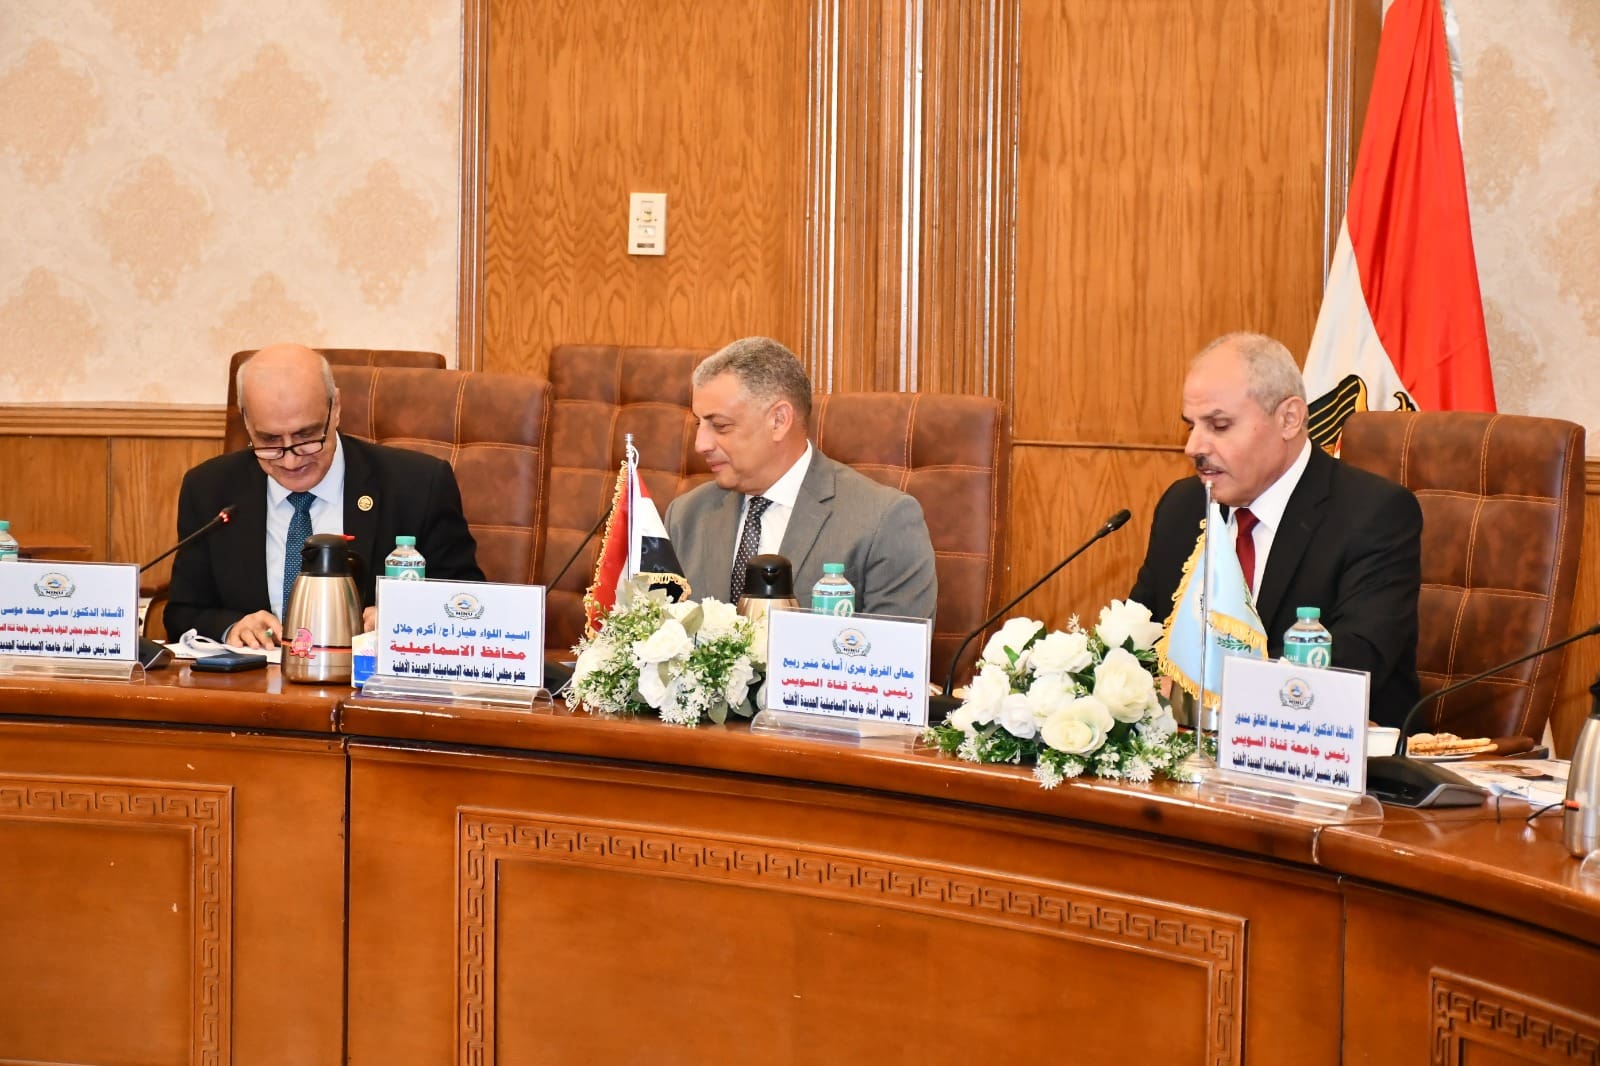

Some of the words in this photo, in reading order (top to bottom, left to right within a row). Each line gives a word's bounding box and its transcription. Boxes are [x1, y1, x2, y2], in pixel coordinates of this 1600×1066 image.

[26, 607, 45, 615] محمد
[100, 606, 124, 618] الأستاذ
[392, 623, 413, 635] جلال
[416, 622, 436, 637] أكرم
[456, 625, 477, 638] طيار
[480, 626, 502, 639] اللواء
[505, 629, 530, 641] السيد
[45, 640, 61, 654] جامعة
[76, 642, 92, 655] مجلس
[480, 645, 527, 660] محافظ
[411, 661, 431, 677] الجديدة
[783, 657, 799, 669] ربيع
[802, 658, 819, 670] منير
[821, 657, 843, 670] أسامة
[463, 664, 480, 680] جامعة
[496, 667, 512, 682] مجلس
[868, 664, 892, 677] الفريق
[781, 678, 823, 688] السويس
[827, 679, 848, 690] قناة
[851, 681, 878, 695] هيئة
[883, 686, 914, 699] رئيس
[800, 694, 819, 711] الجديدة
[848, 699, 864, 717] جامعة
[879, 703, 895, 719] مجلس
[1231, 735, 1267, 748] السويس
[1269, 737, 1288, 751] قناة
[1290, 740, 1320, 758] جامعة
[1324, 747, 1350, 764] رئيس
[1287, 760, 1301, 777] جامعة
